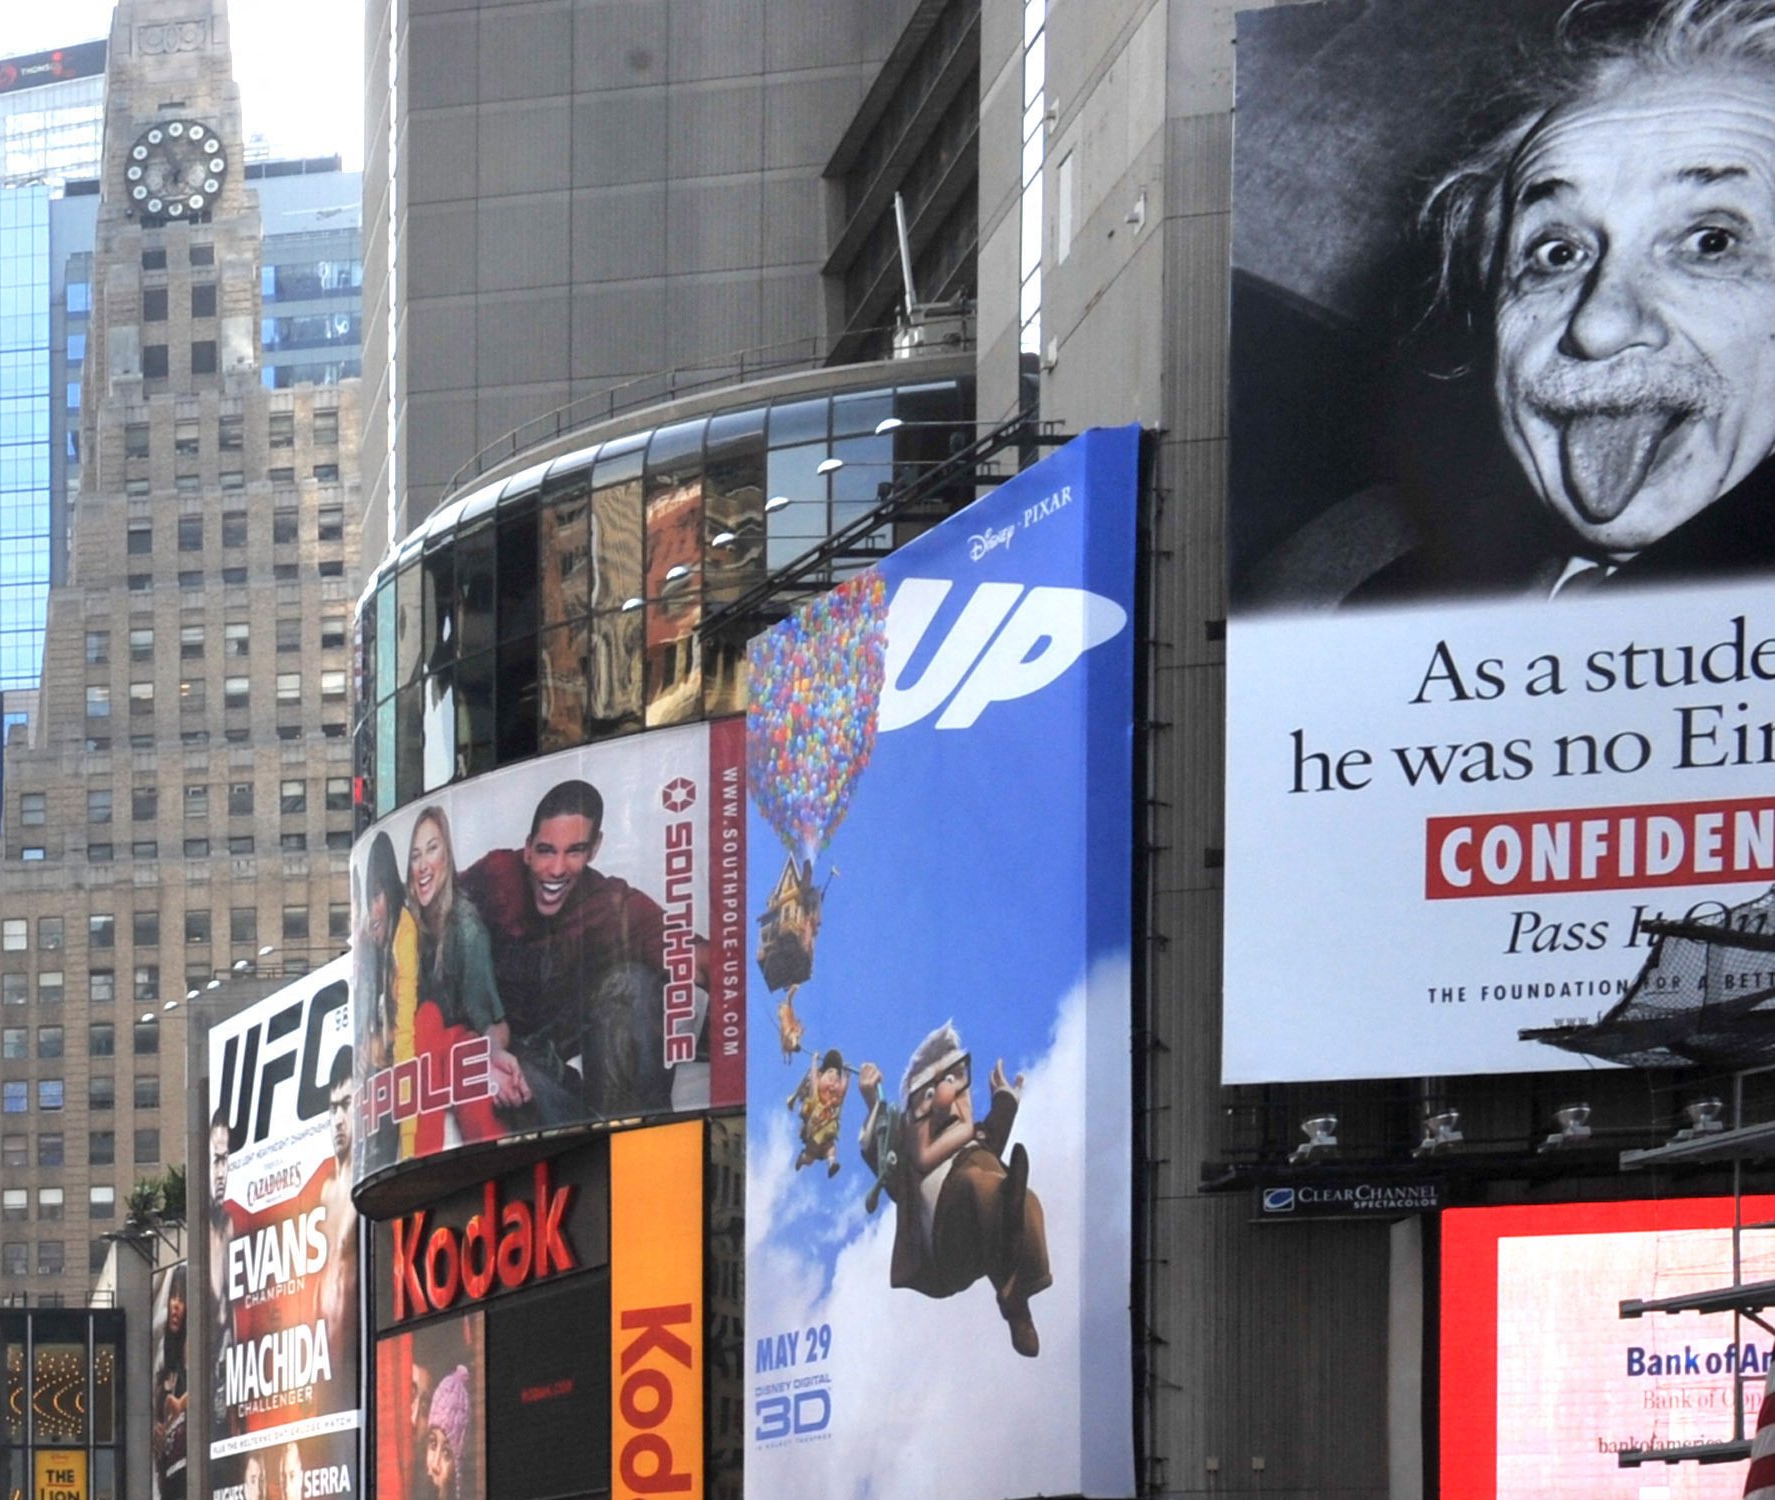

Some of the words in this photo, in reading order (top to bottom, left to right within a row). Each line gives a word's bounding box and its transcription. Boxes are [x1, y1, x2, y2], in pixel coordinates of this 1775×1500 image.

[967, 521, 1015, 562] Disney
[1023, 484, 1073, 530] PIXAR
[876, 577, 1128, 732] UP
[1409, 640, 1505, 704] As
[1527, 654, 1561, 695] a
[1288, 729, 1371, 794] he
[1392, 739, 1533, 787] was
[1553, 728, 1650, 777] no
[663, 820, 696, 1066] SOUTHPOLE
[722, 766, 739, 1056] WWW.SOUTHPOLE-USA.COM
[1503, 908, 1608, 955] Pass
[1428, 987, 1470, 1004] THE
[1481, 979, 1628, 1001] FOUNDATION
[223, 979, 352, 1150] UFC
[229, 1206, 327, 1301] EVANS
[391, 1160, 578, 1321] Kodak
[245, 1278, 305, 1309] CHAMPION
[226, 1317, 331, 1407] MACHIDA
[756, 1332, 799, 1374] MAY
[805, 1323, 832, 1362] 29
[238, 1387, 313, 1419] CHALLENGER
[755, 1379, 792, 1397] DISNEY
[794, 1372, 832, 1389] DIGITAL
[756, 1388, 832, 1441] 3D
[46, 1469, 75, 1484] THE
[303, 1464, 351, 1498] SERRA
